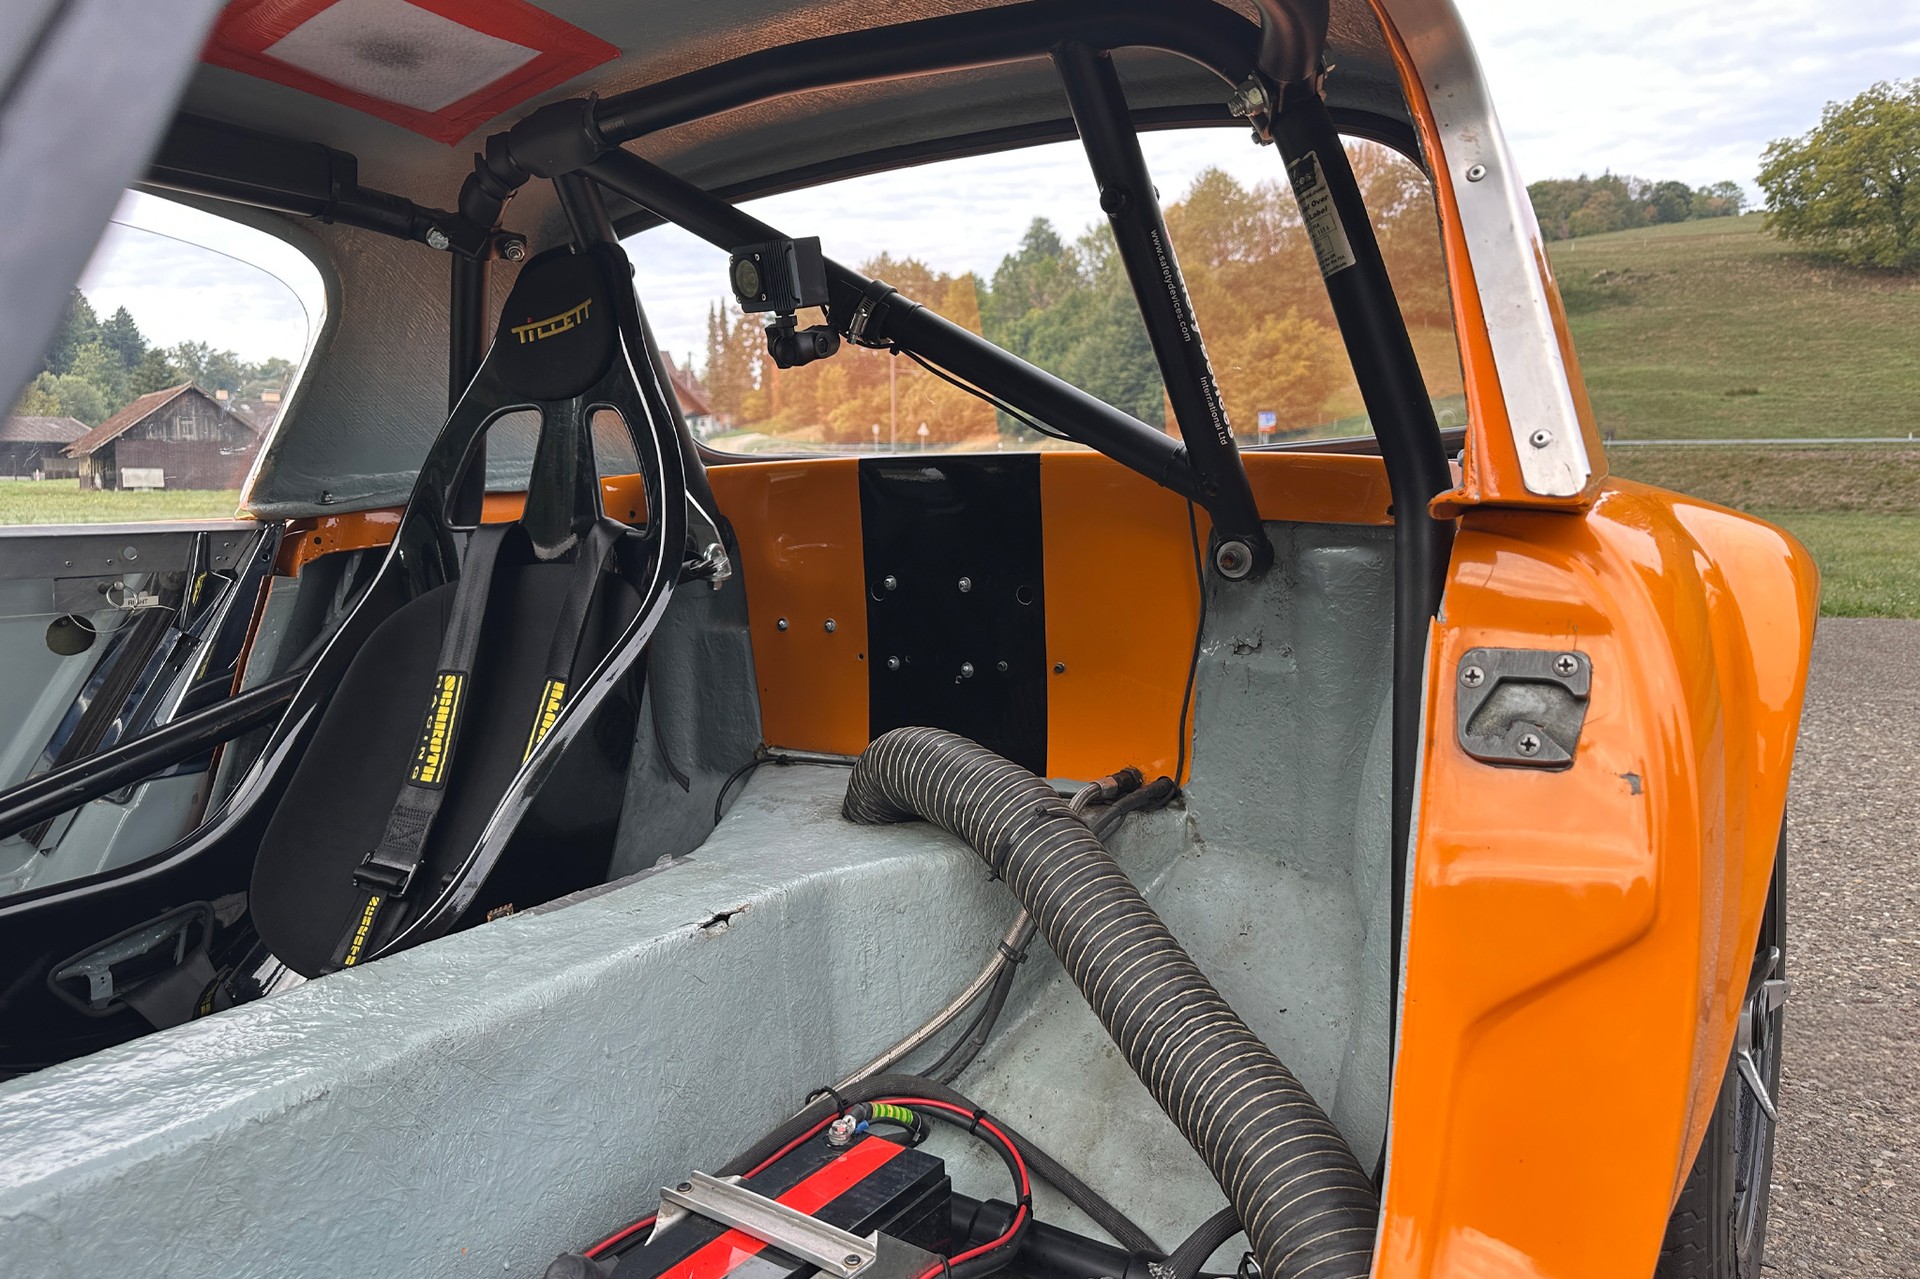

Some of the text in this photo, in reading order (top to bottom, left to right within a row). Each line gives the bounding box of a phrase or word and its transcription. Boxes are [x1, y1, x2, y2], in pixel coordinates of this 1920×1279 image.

[1309, 205, 1328, 220] Label
[1311, 194, 1329, 207] Over
[1150, 229, 1191, 342] www.safetydevices.com
[511, 298, 592, 344] TILLETT
[1218, 430, 1228, 446] Ltd
[127, 598, 148, 606] RIHT
[411, 675, 443, 780] RACING
[420, 675, 456, 782] SCHROTH
[344, 896, 380, 966] SCHROTH
